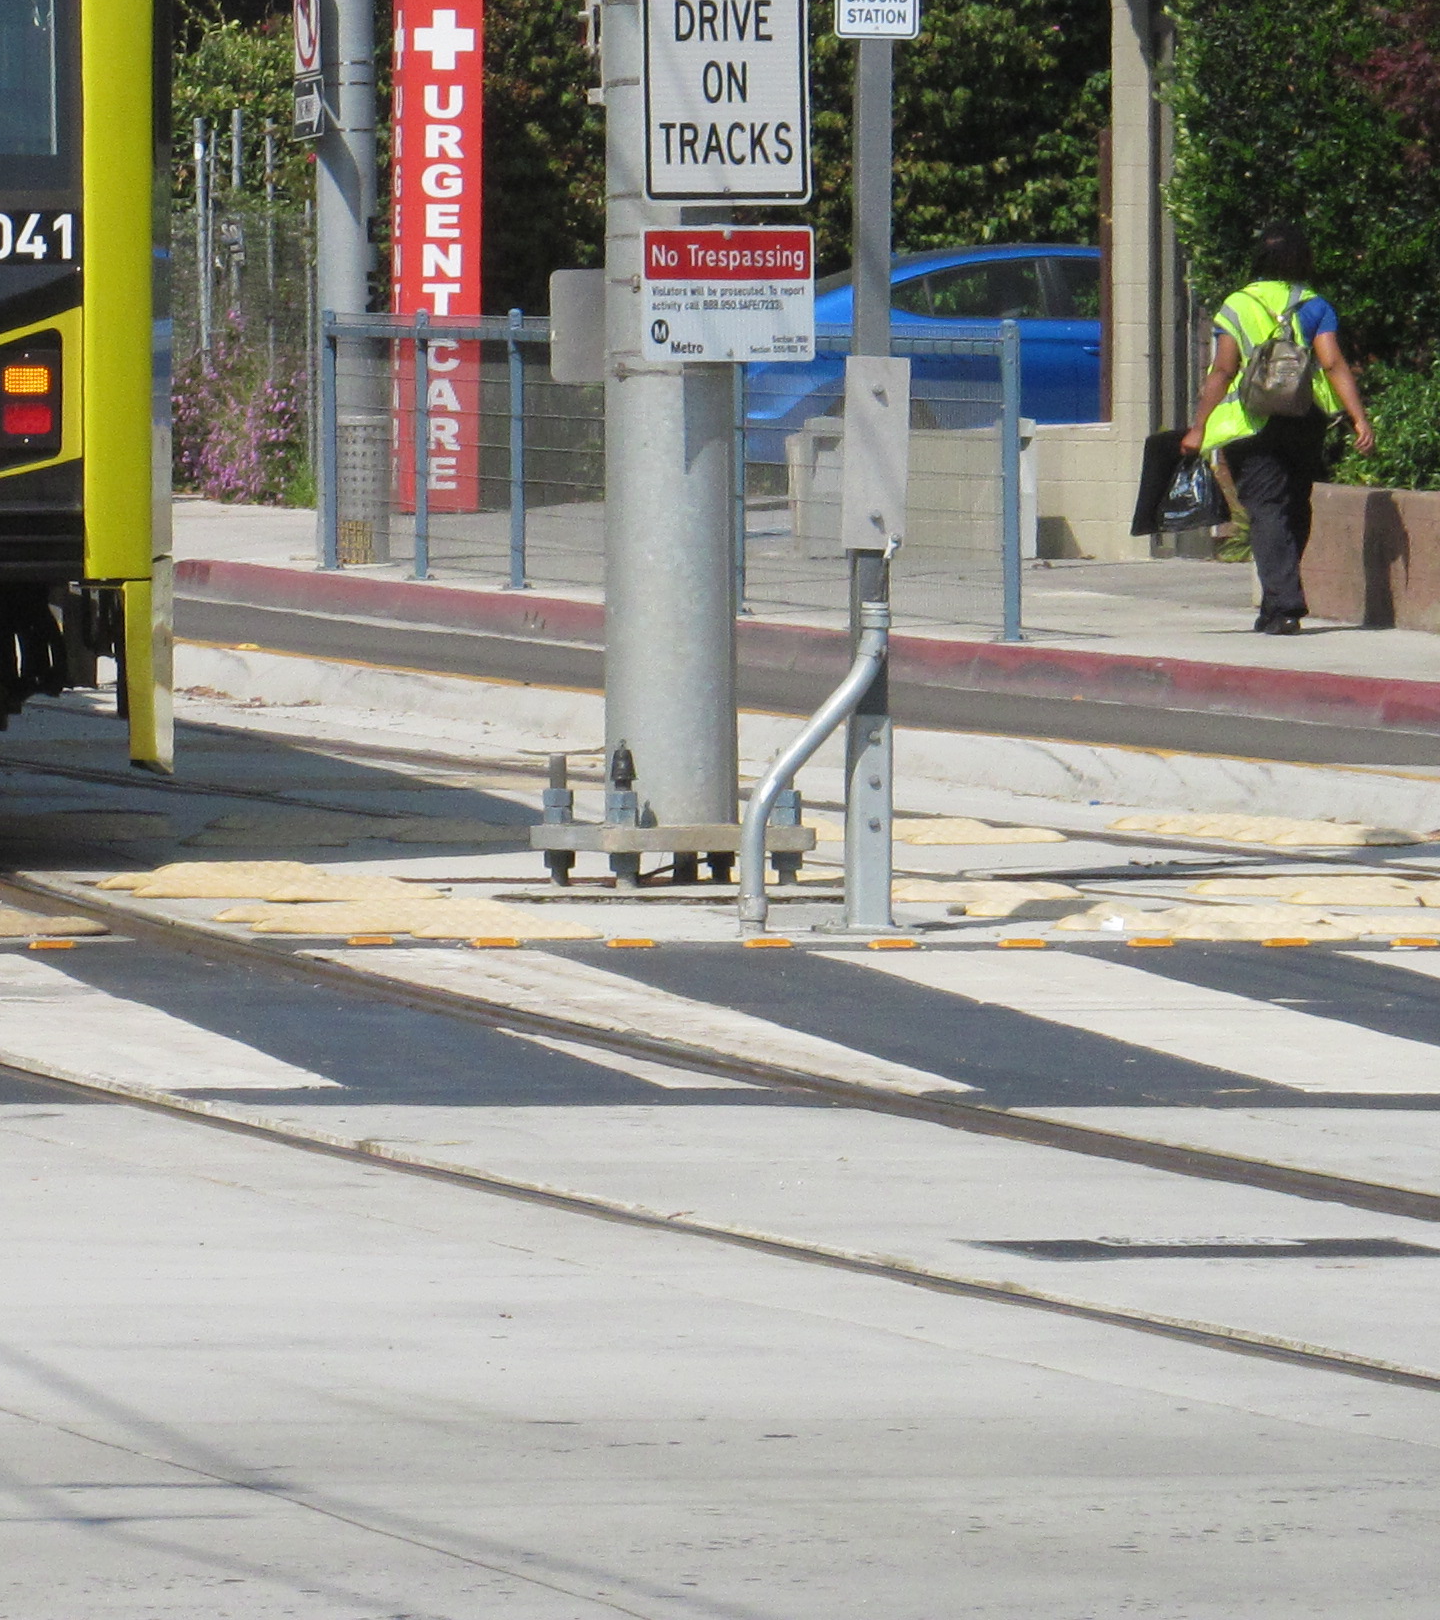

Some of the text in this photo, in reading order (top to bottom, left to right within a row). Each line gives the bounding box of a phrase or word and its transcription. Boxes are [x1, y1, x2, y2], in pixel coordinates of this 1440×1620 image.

[675, 0, 773, 42] DRIVE
[847, 8, 907, 23] STATION
[702, 60, 748, 103] ON
[659, 121, 793, 165] TRACKS
[651, 244, 805, 271] No Trespassing
[421, 85, 465, 490] URGENT CARE
[671, 341, 704, 354] Metro
